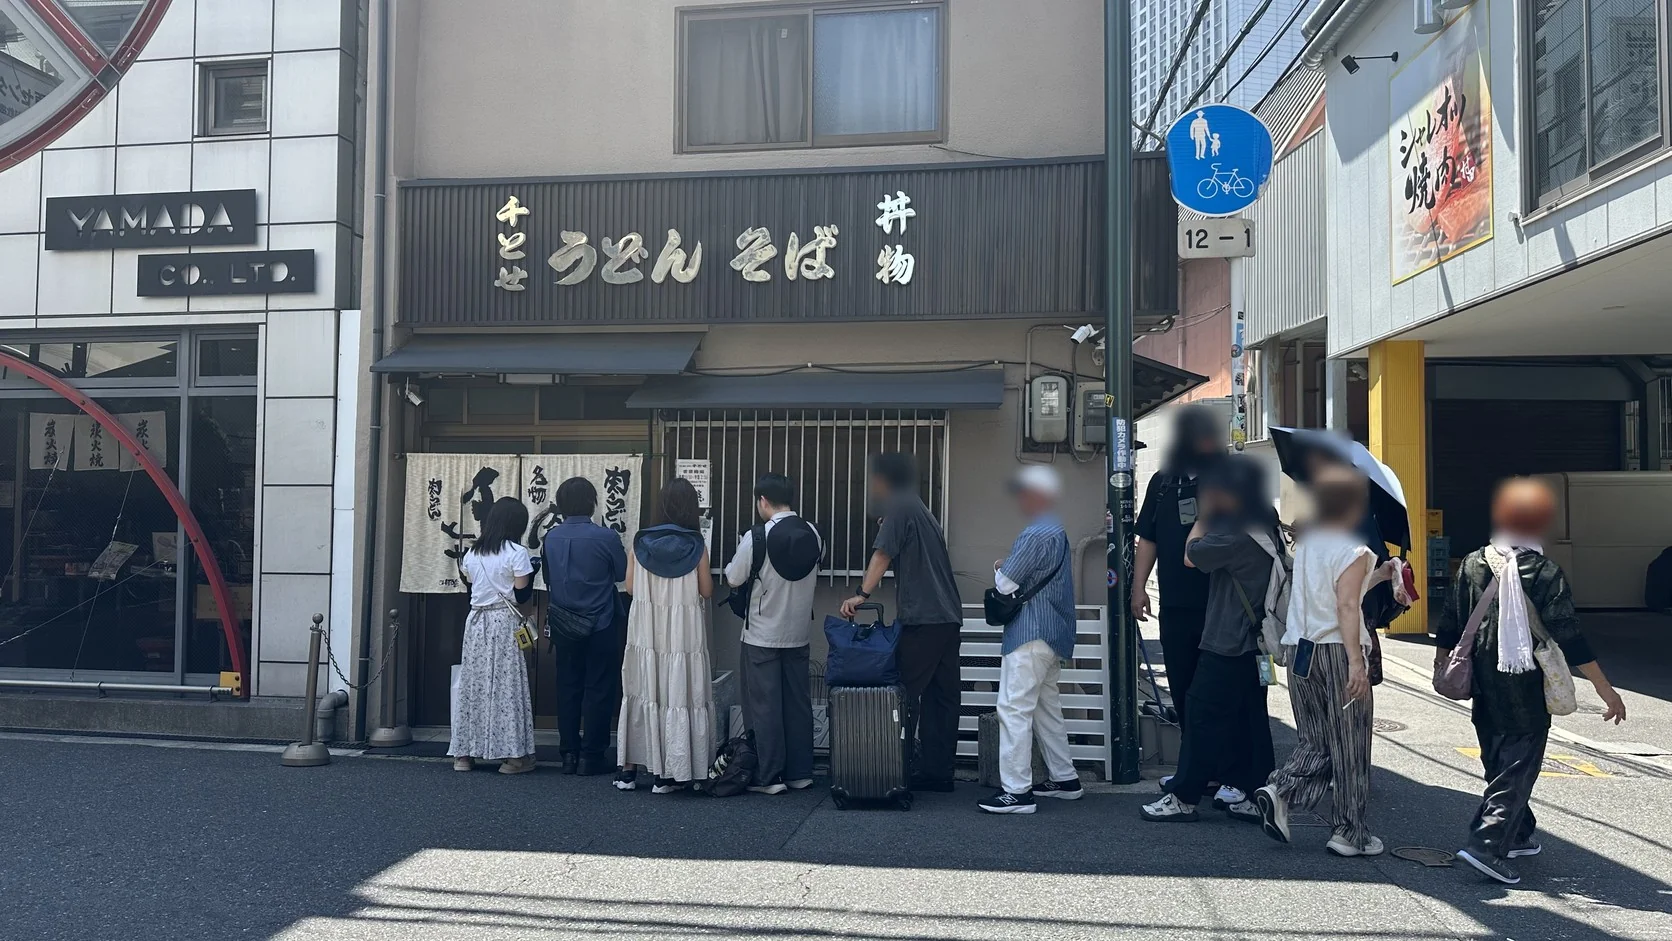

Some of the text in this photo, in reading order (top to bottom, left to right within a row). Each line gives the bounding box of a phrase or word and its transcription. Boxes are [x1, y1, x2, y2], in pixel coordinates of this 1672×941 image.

[1400, 86, 1466, 168] シャレオツ
[1405, 146, 1461, 214] 焼肉
[66, 203, 234, 237] YAMADA
[495, 196, 529, 291] 千とせ
[876, 191, 916, 285] 丼物
[230, 261, 296, 283] LTD.
[547, 223, 839, 286] うどん そば
[528, 465, 548, 505] 名物
